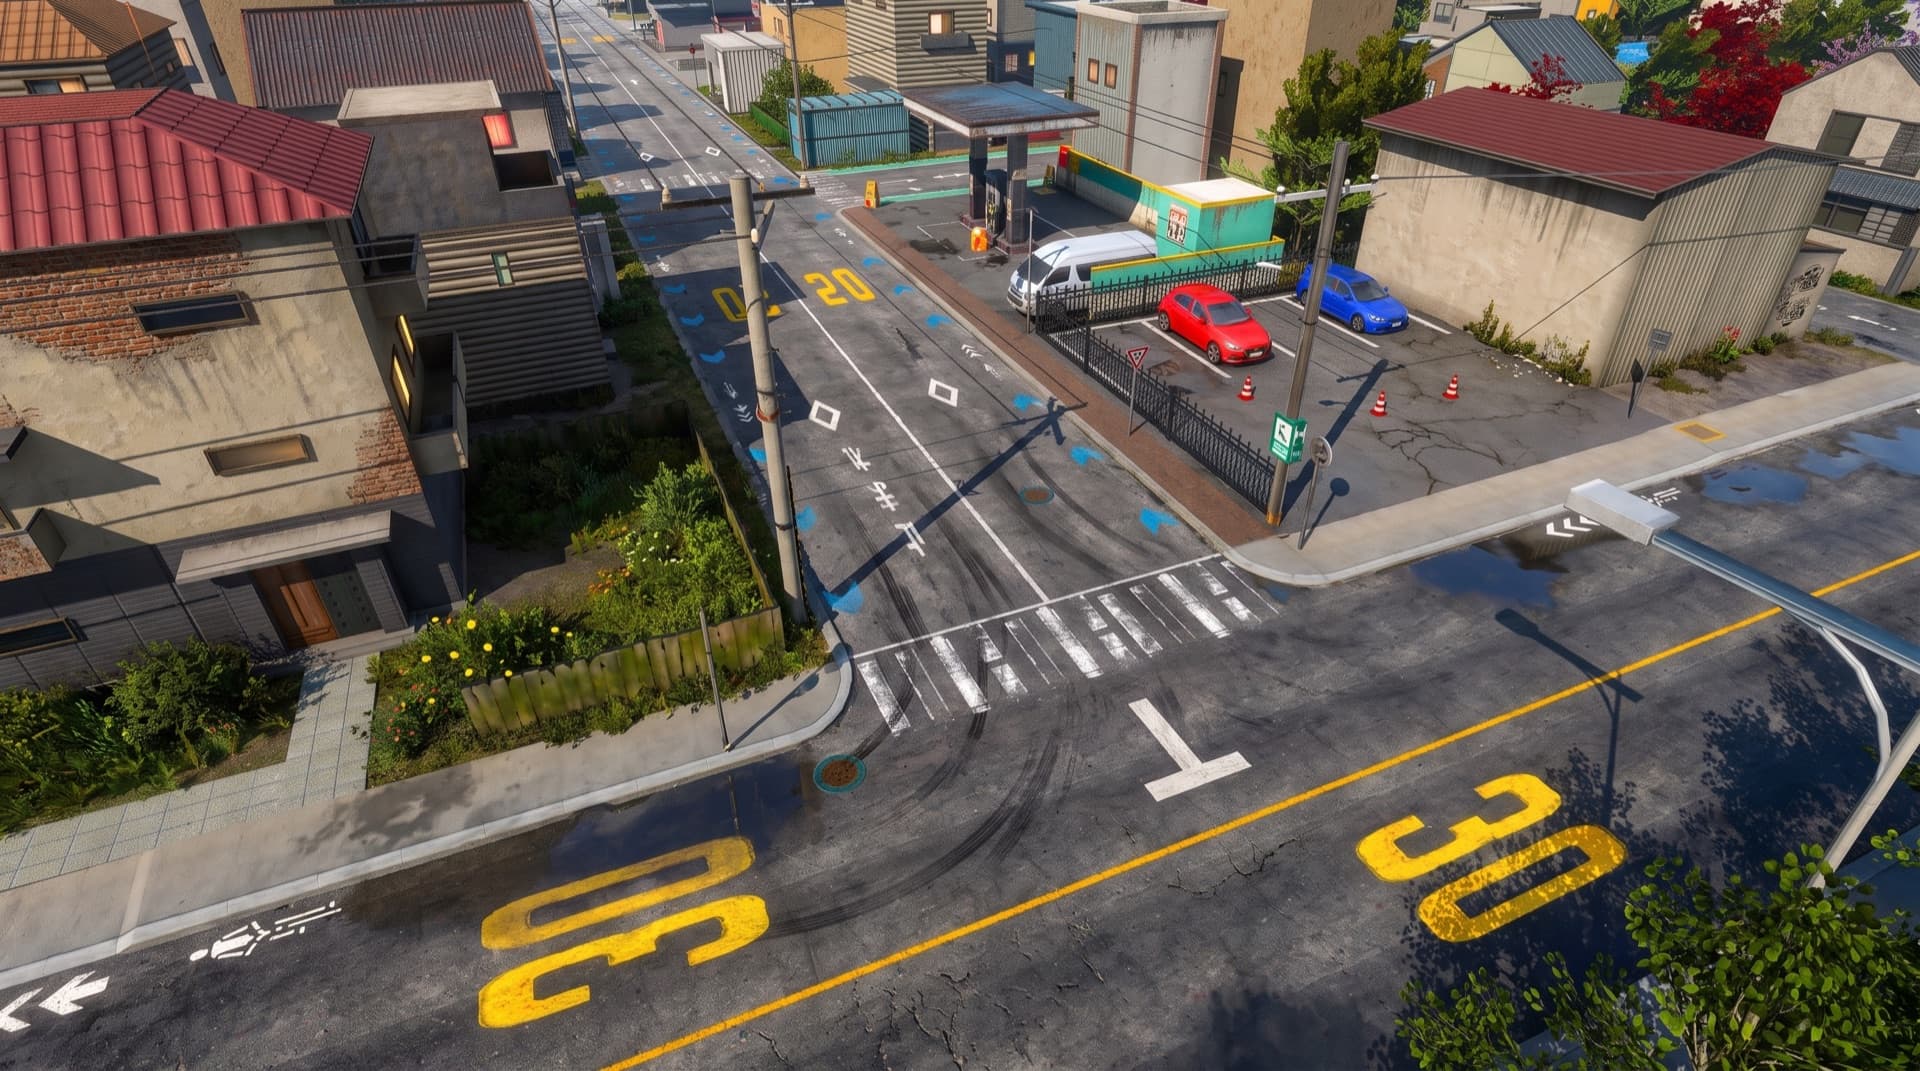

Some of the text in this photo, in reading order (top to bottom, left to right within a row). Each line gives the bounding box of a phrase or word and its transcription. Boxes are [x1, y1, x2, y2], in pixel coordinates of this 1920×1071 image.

[712, 288, 782, 322] 0
[803, 268, 876, 307] 20
[1356, 773, 1627, 942] 30
[478, 836, 769, 1028] 30
